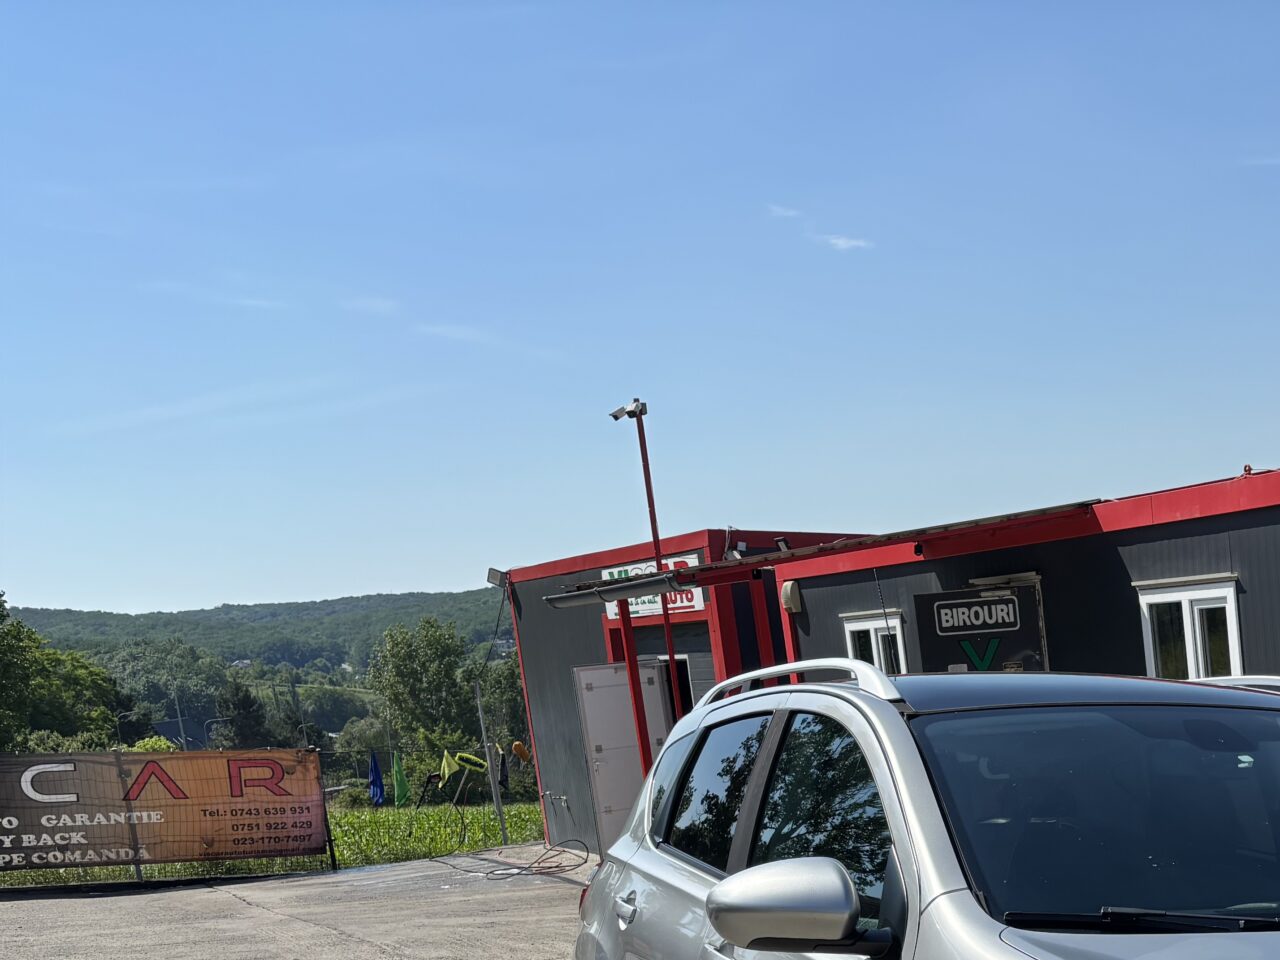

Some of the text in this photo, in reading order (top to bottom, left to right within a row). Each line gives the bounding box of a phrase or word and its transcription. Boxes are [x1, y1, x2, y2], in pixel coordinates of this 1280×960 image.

[940, 603, 1015, 628] BIROURI
[41, 811, 165, 828] GARANTIE
[201, 806, 312, 817] Tel.: 0743 639 931
[232, 820, 313, 832] 0751 922 429
[21, 831, 88, 847] BACK
